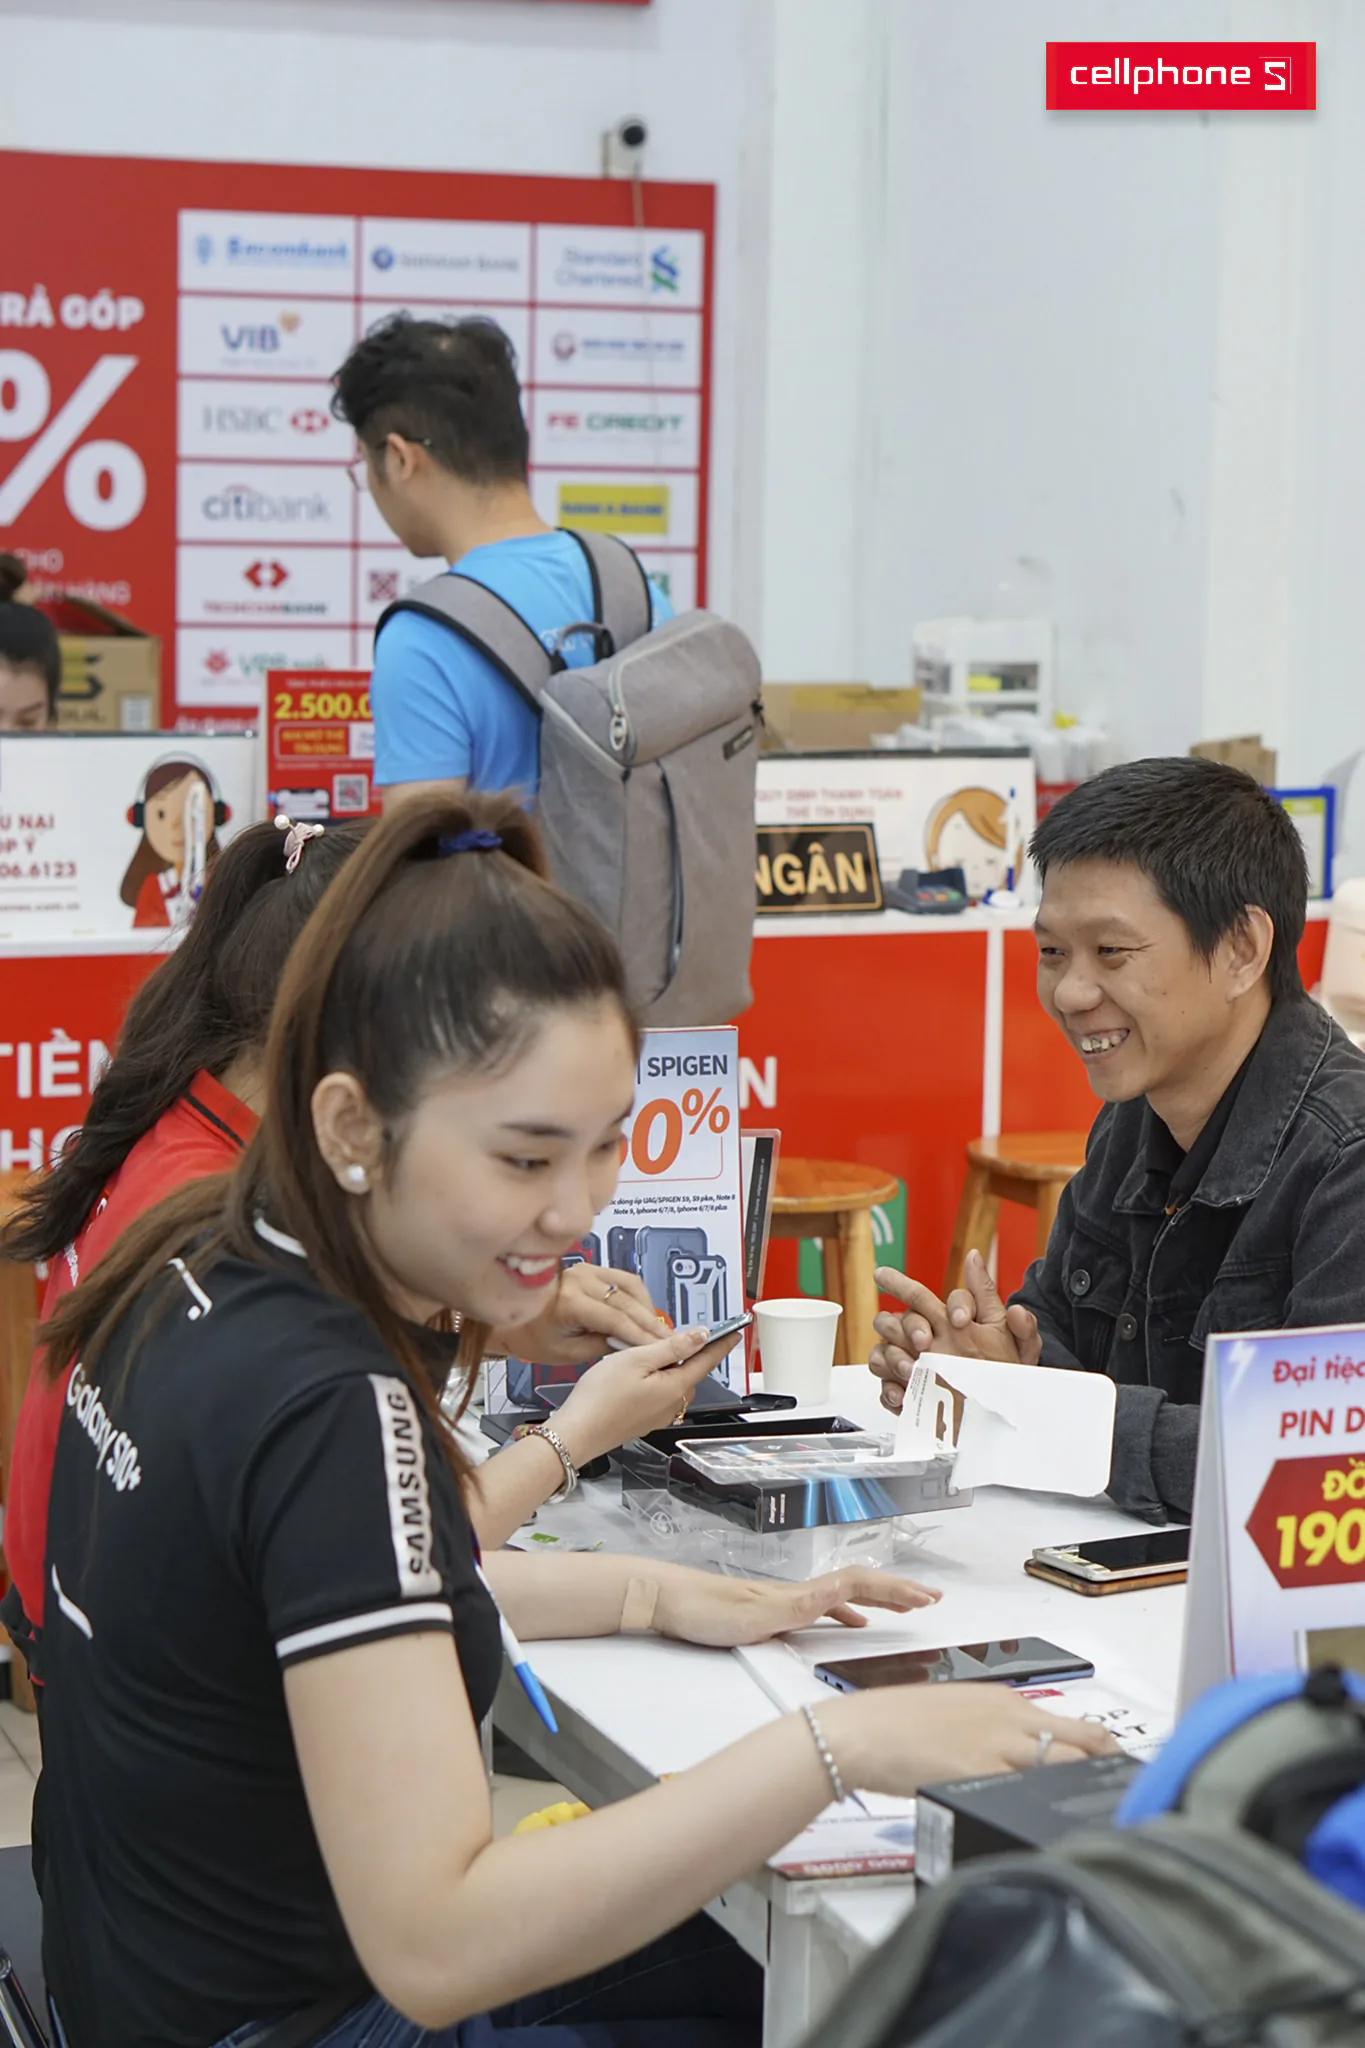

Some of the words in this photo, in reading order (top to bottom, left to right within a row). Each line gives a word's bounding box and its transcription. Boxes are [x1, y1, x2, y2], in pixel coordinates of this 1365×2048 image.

[220, 322, 279, 353] VIB
[202, 404, 283, 434] HSBC
[547, 411, 579, 430] FE
[585, 410, 684, 431] CREDIT
[201, 489, 331, 522] citibank
[647, 1054, 729, 1077] SPIGEN
[619, 1086, 731, 1176] 0%
[1272, 1356, 1316, 1388] Đại
[67, 1362, 118, 1470] Galaxy
[106, 1432, 142, 1492] S10+
[1279, 1408, 1334, 1438] PIN
[387, 1393, 428, 1575] SAMSUNG
